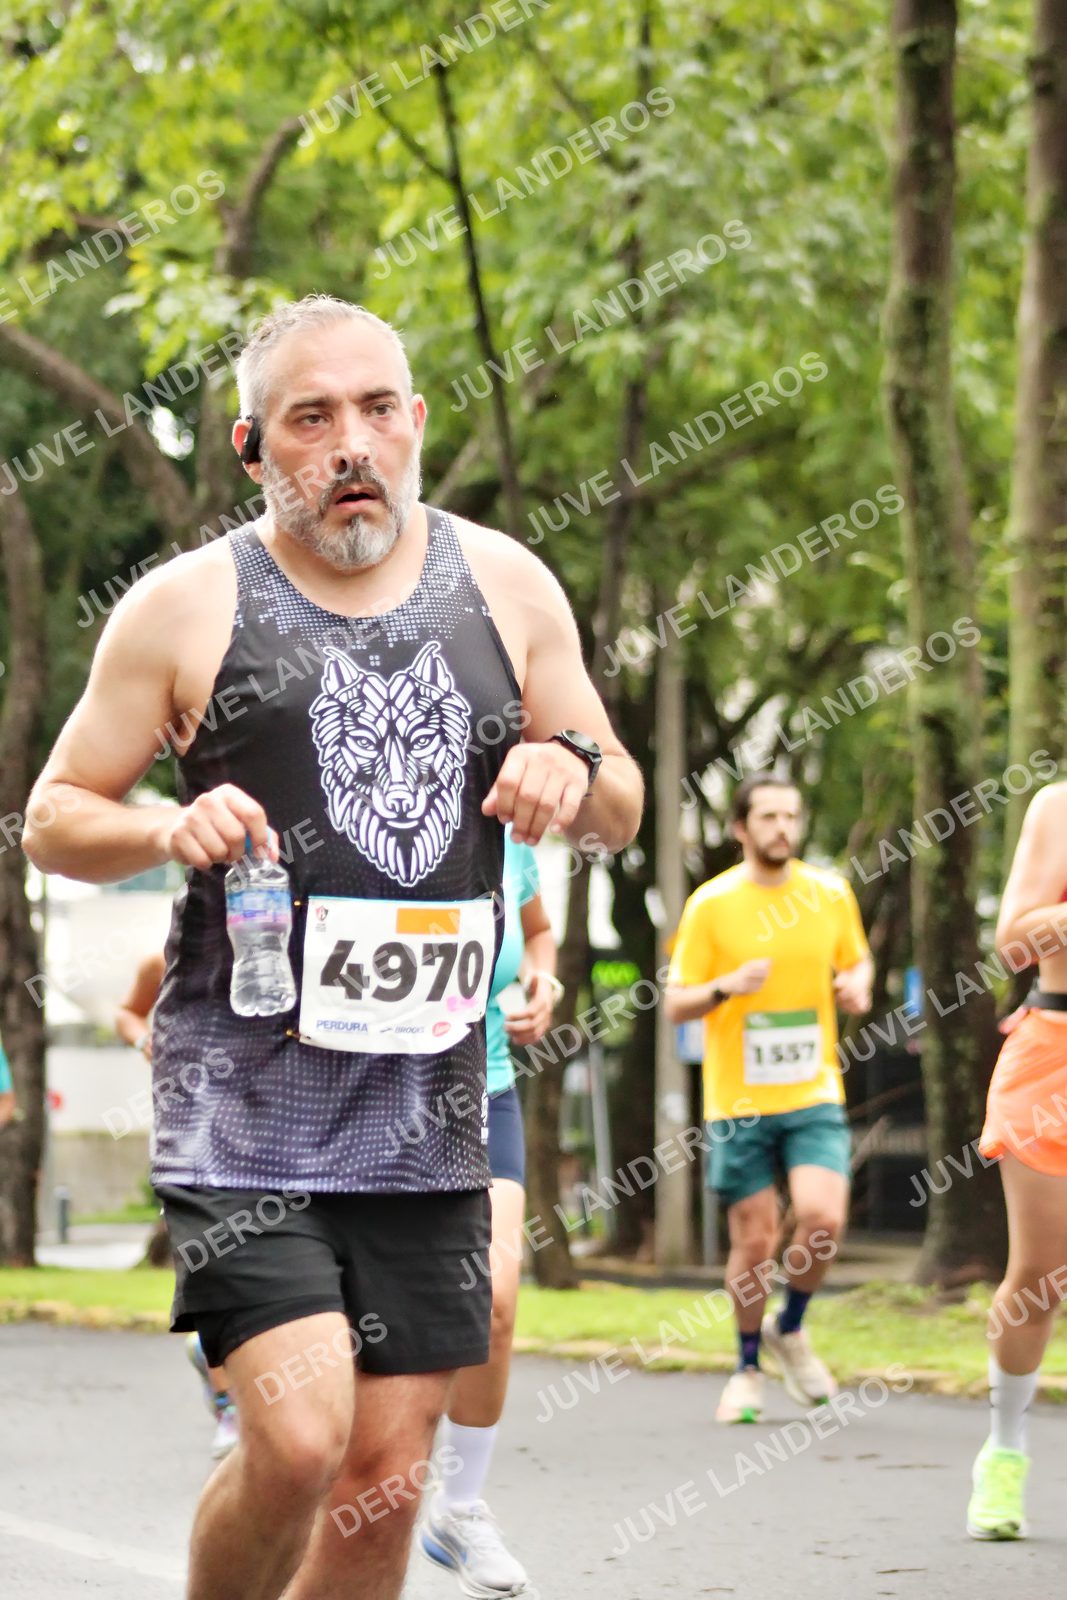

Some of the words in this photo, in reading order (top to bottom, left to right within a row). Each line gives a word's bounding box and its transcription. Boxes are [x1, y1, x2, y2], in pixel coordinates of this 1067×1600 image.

[320, 940, 484, 1003] 4970
[316, 1019, 368, 1032] PERDURA
[752, 1041, 815, 1067] 1557
